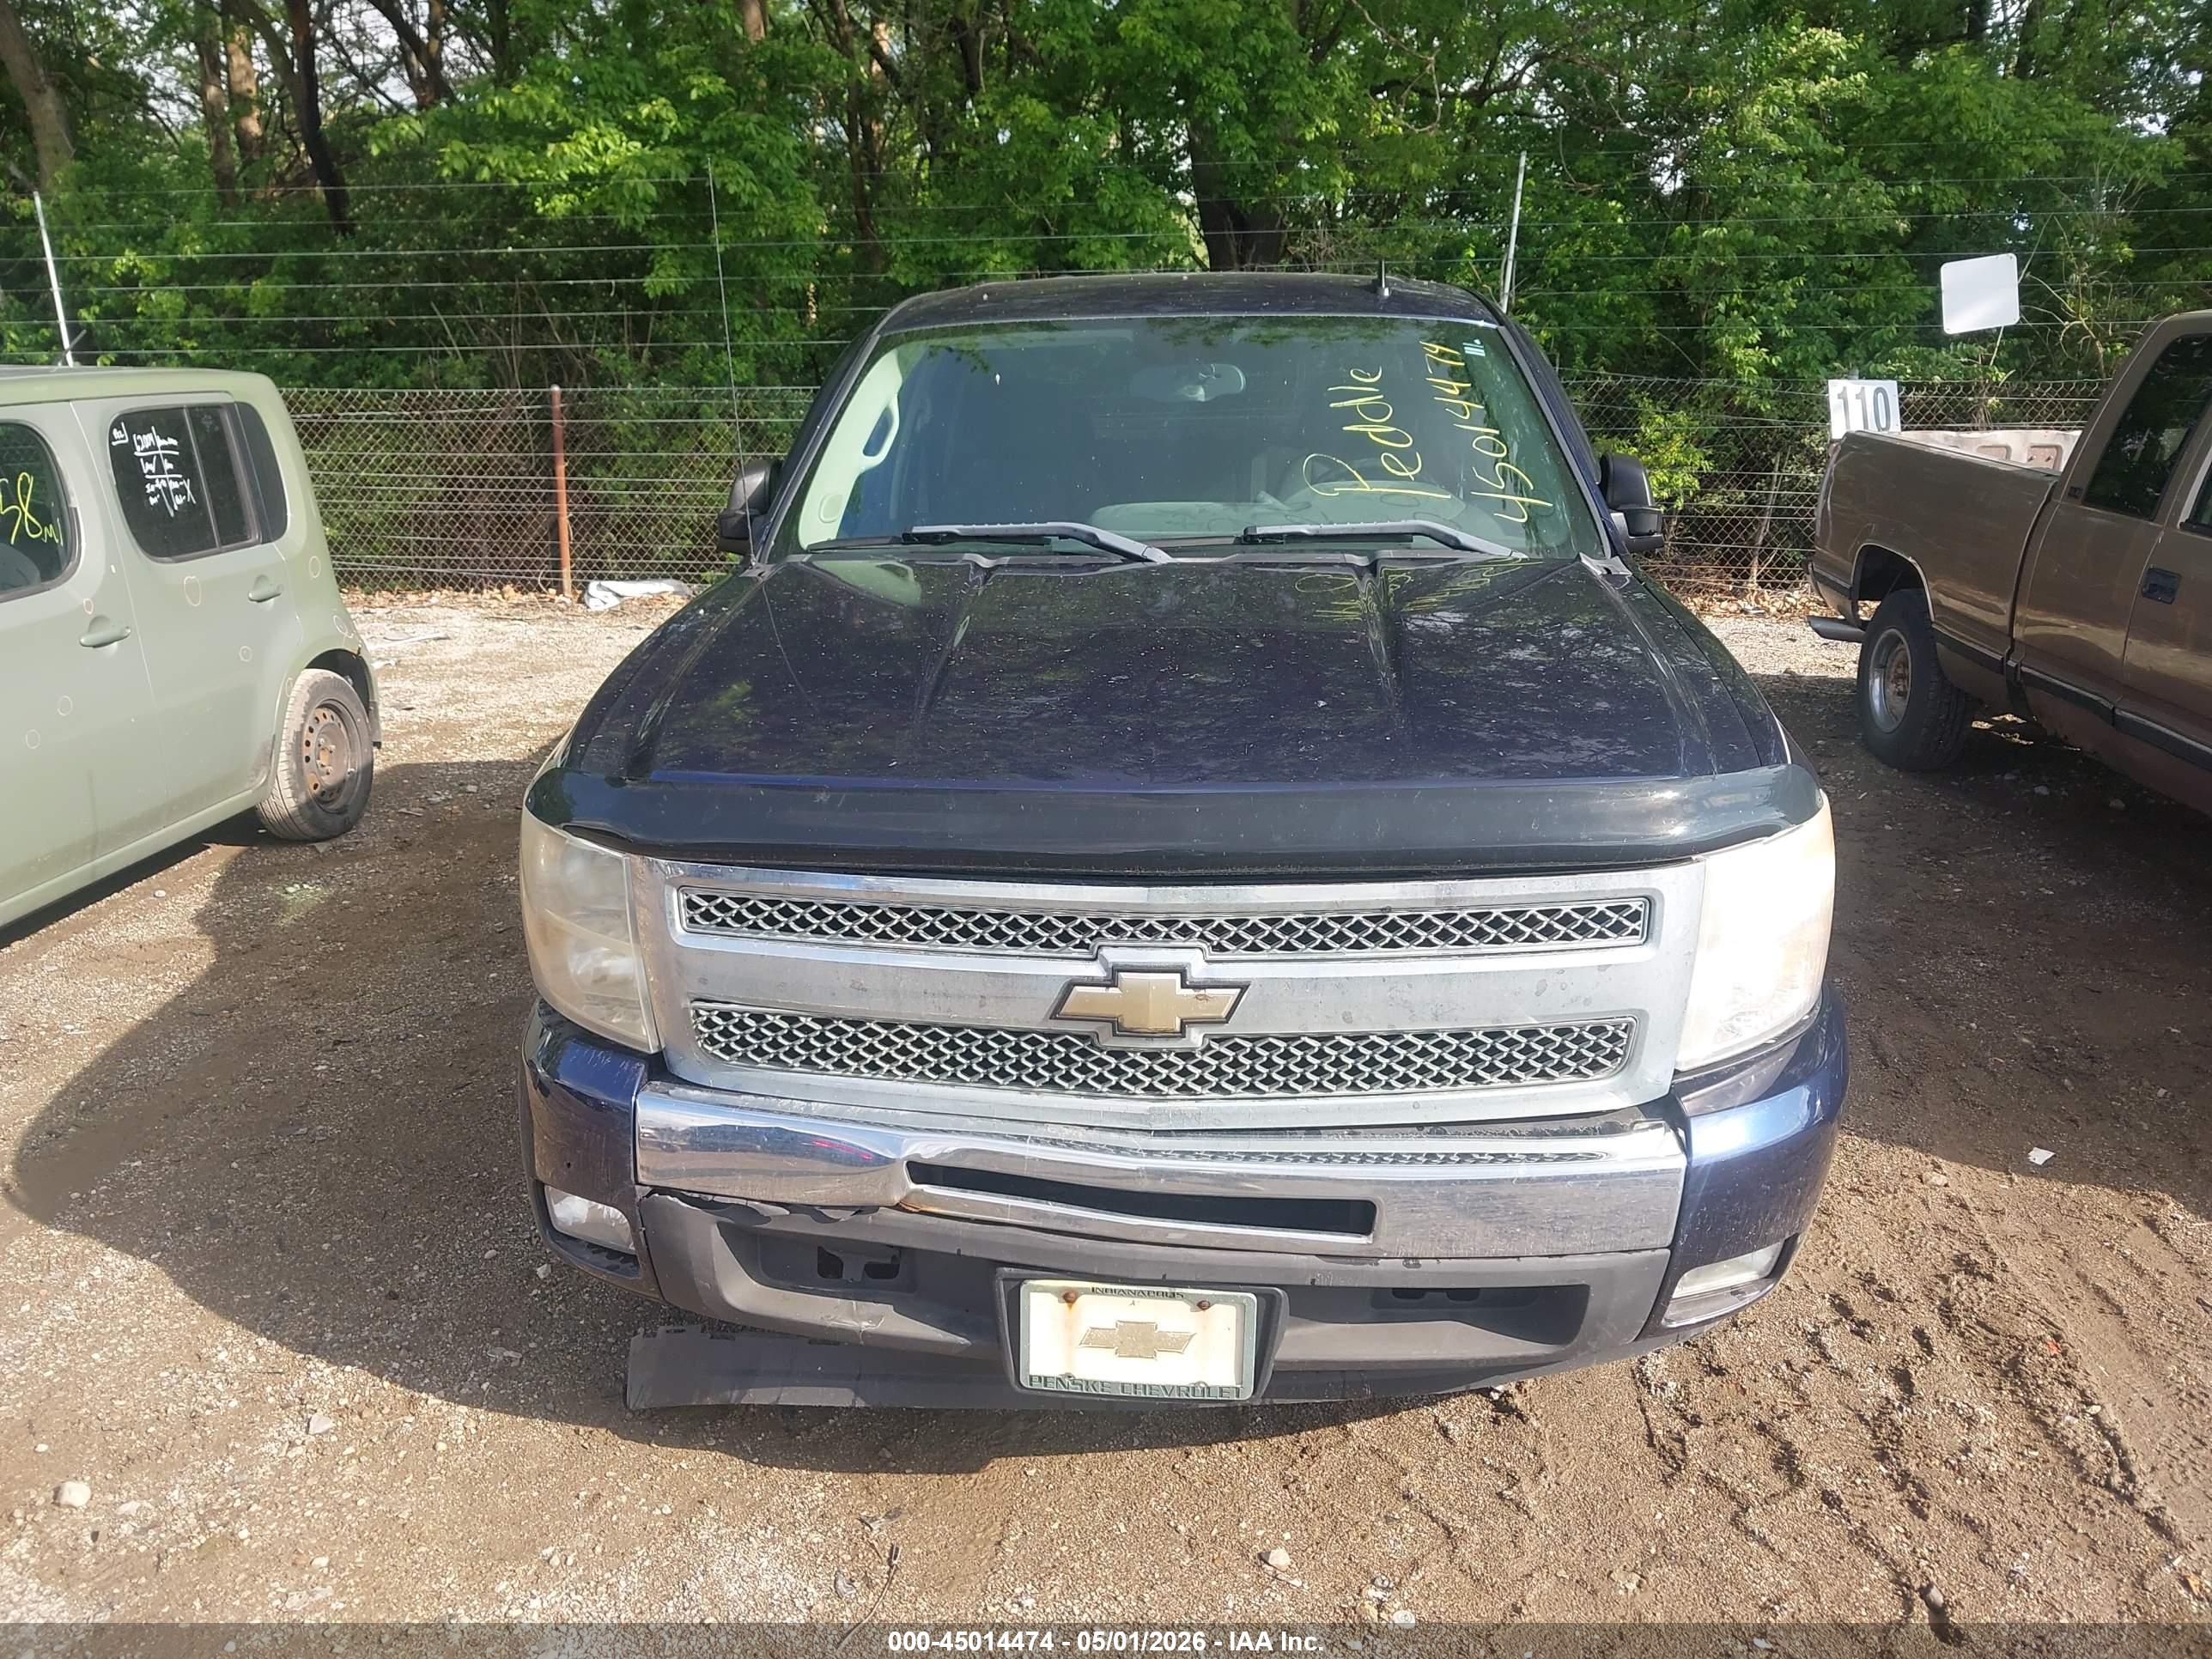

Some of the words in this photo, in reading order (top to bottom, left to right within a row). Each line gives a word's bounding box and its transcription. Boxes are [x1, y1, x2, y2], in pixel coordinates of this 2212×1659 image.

[1302, 366, 1452, 498] Peddle
[1419, 340, 1553, 524] 45014474
[1837, 386, 1892, 432] 110
[1091, 1286, 1184, 1299] INDIANAPOLIS
[1029, 1375, 1112, 1394] PENSKE
[1120, 1382, 1244, 1400] CHEVROLET
